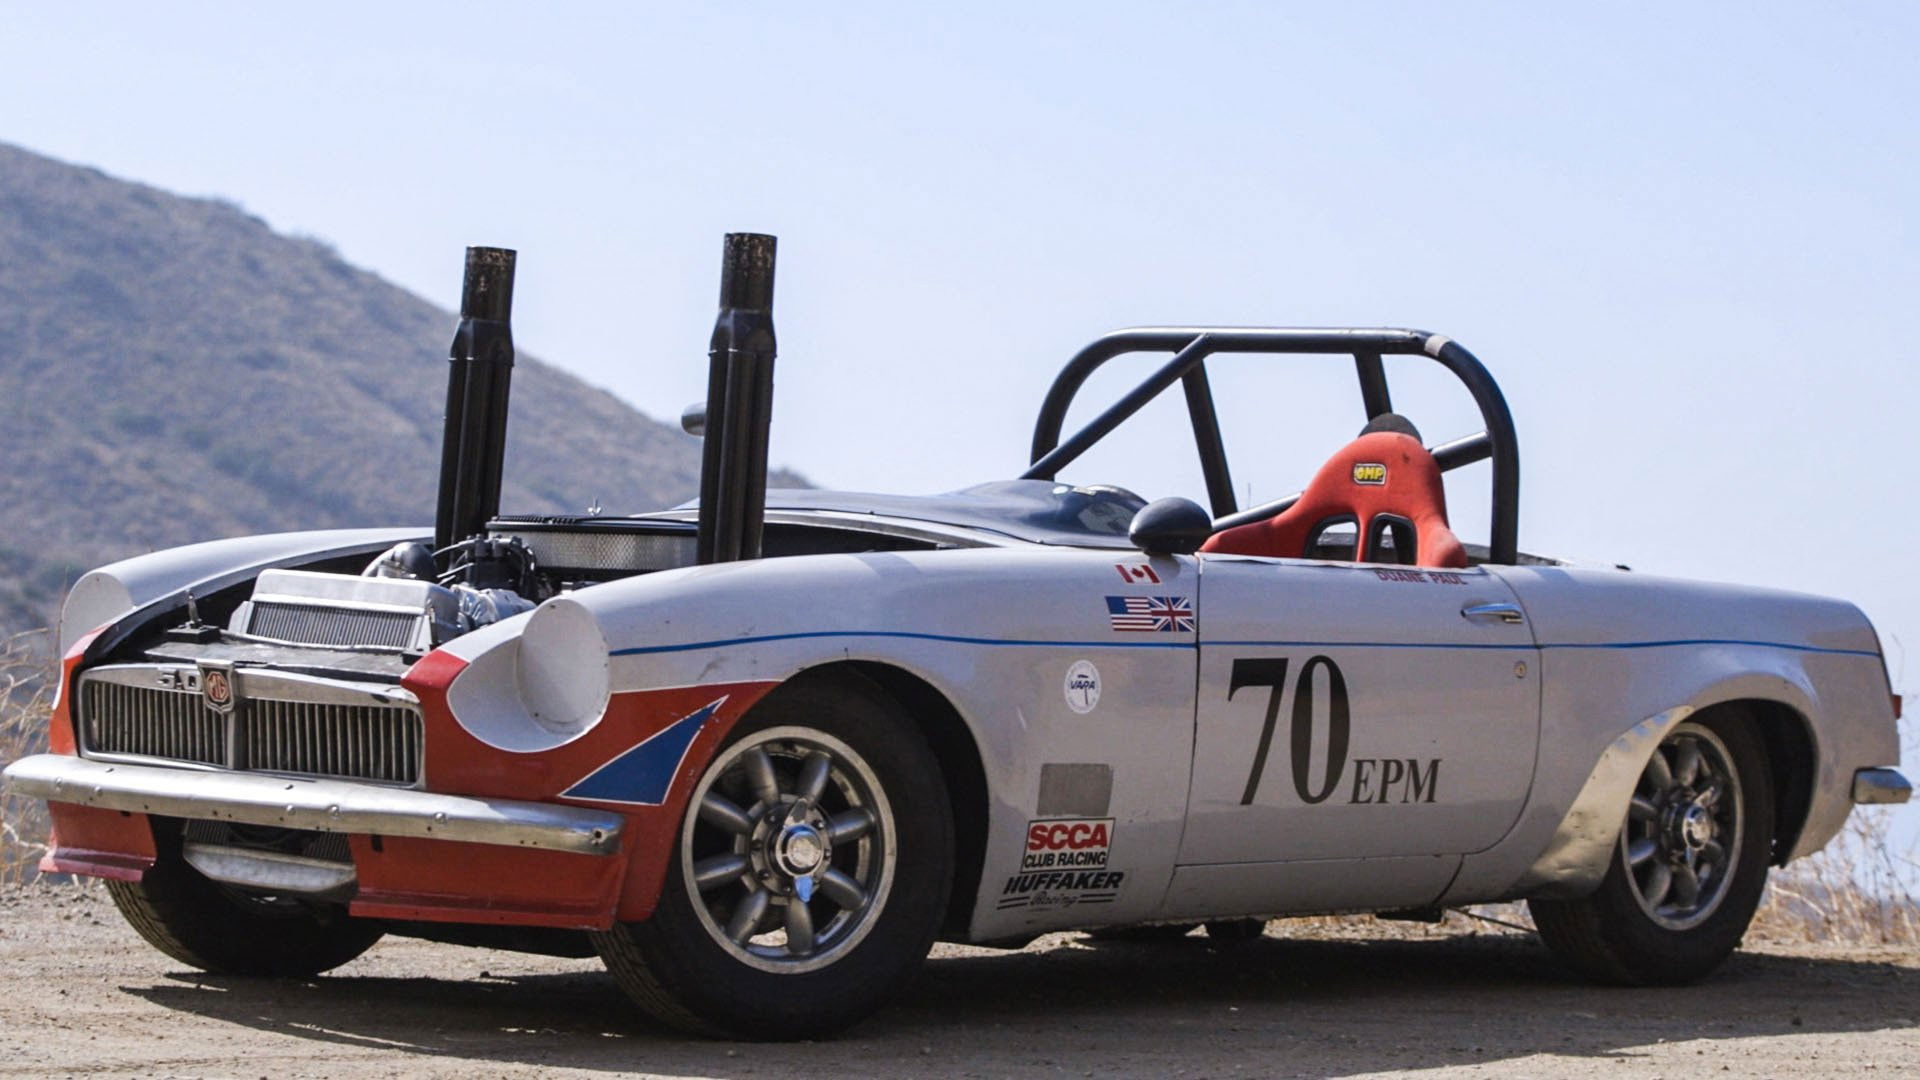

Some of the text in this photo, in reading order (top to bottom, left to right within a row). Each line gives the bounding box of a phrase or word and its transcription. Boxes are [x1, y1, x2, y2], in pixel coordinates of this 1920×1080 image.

[207, 672, 229, 700] MG
[1228, 655, 1442, 805] 70 EPM
[1028, 824, 1108, 850] SCCA
[1024, 851, 1106, 868] CLUB RACING
[1003, 871, 1124, 894] HUFFAKER
